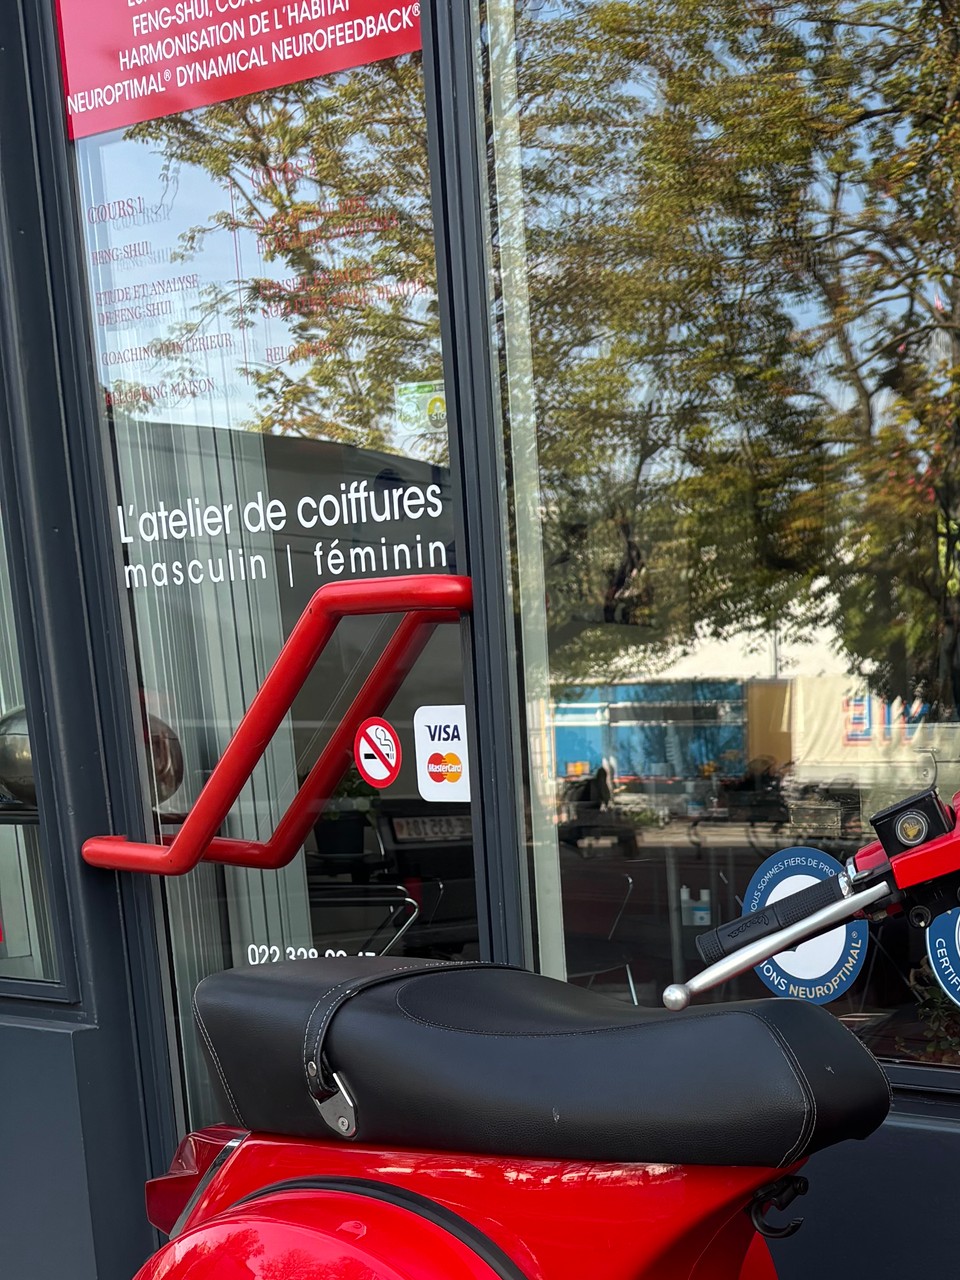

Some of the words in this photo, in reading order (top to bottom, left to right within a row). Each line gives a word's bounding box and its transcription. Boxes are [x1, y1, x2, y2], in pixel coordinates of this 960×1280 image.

[119, 18, 245, 71] HARMONISATION
[250, 11, 270, 36] DE
[176, 45, 268, 87] DYNAMICAL
[88, 198, 134, 225] COURS
[91, 241, 149, 266] FENG-SHUI
[133, 283, 148, 299] ET
[150, 273, 200, 296] ANALYSE
[101, 344, 160, 366] COACHING
[170, 377, 215, 396] MAISON
[117, 498, 233, 544] L'atelier
[243, 491, 287, 533] de
[297, 480, 443, 529] coiffures
[124, 549, 267, 588] masculin
[313, 534, 447, 576] féminin
[424, 724, 461, 742] VISA
[428, 763, 462, 773] MasterCard
[757, 861, 785, 892] SOMMES
[784, 857, 806, 868] FIERS
[807, 857, 819, 868] DE
[818, 862, 838, 877] PRO
[247, 943, 280, 966] 022
